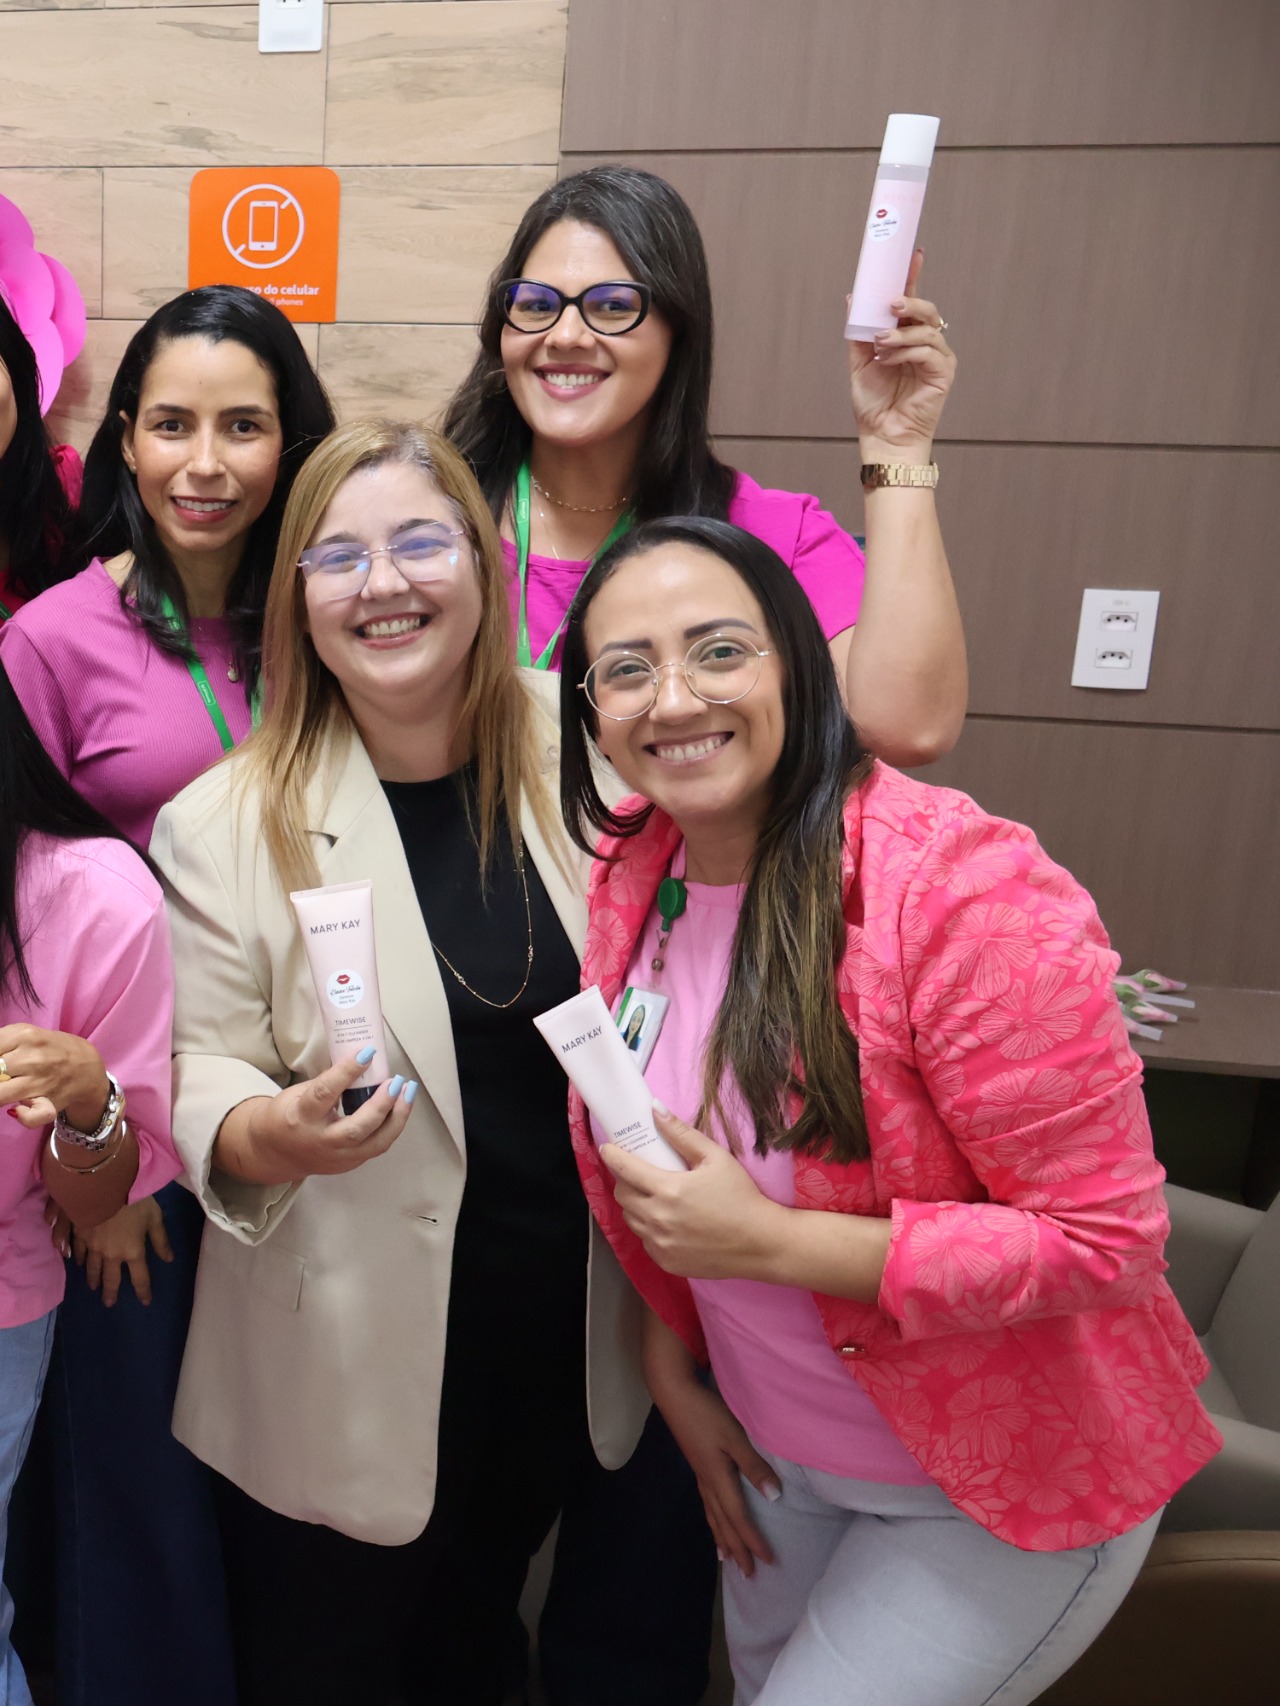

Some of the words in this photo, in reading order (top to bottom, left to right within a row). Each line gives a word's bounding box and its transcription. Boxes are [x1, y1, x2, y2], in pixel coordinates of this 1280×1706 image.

[264, 284, 278, 295] do
[280, 284, 320, 295] celular
[276, 298, 304, 307] phones
[310, 922, 339, 935] MARY
[341, 919, 361, 930] KAY
[334, 1016, 367, 1026] TIMEWISE
[561, 1034, 587, 1053] MARY
[588, 1025, 603, 1040] KAY
[613, 1121, 642, 1139] TIMEWISE
